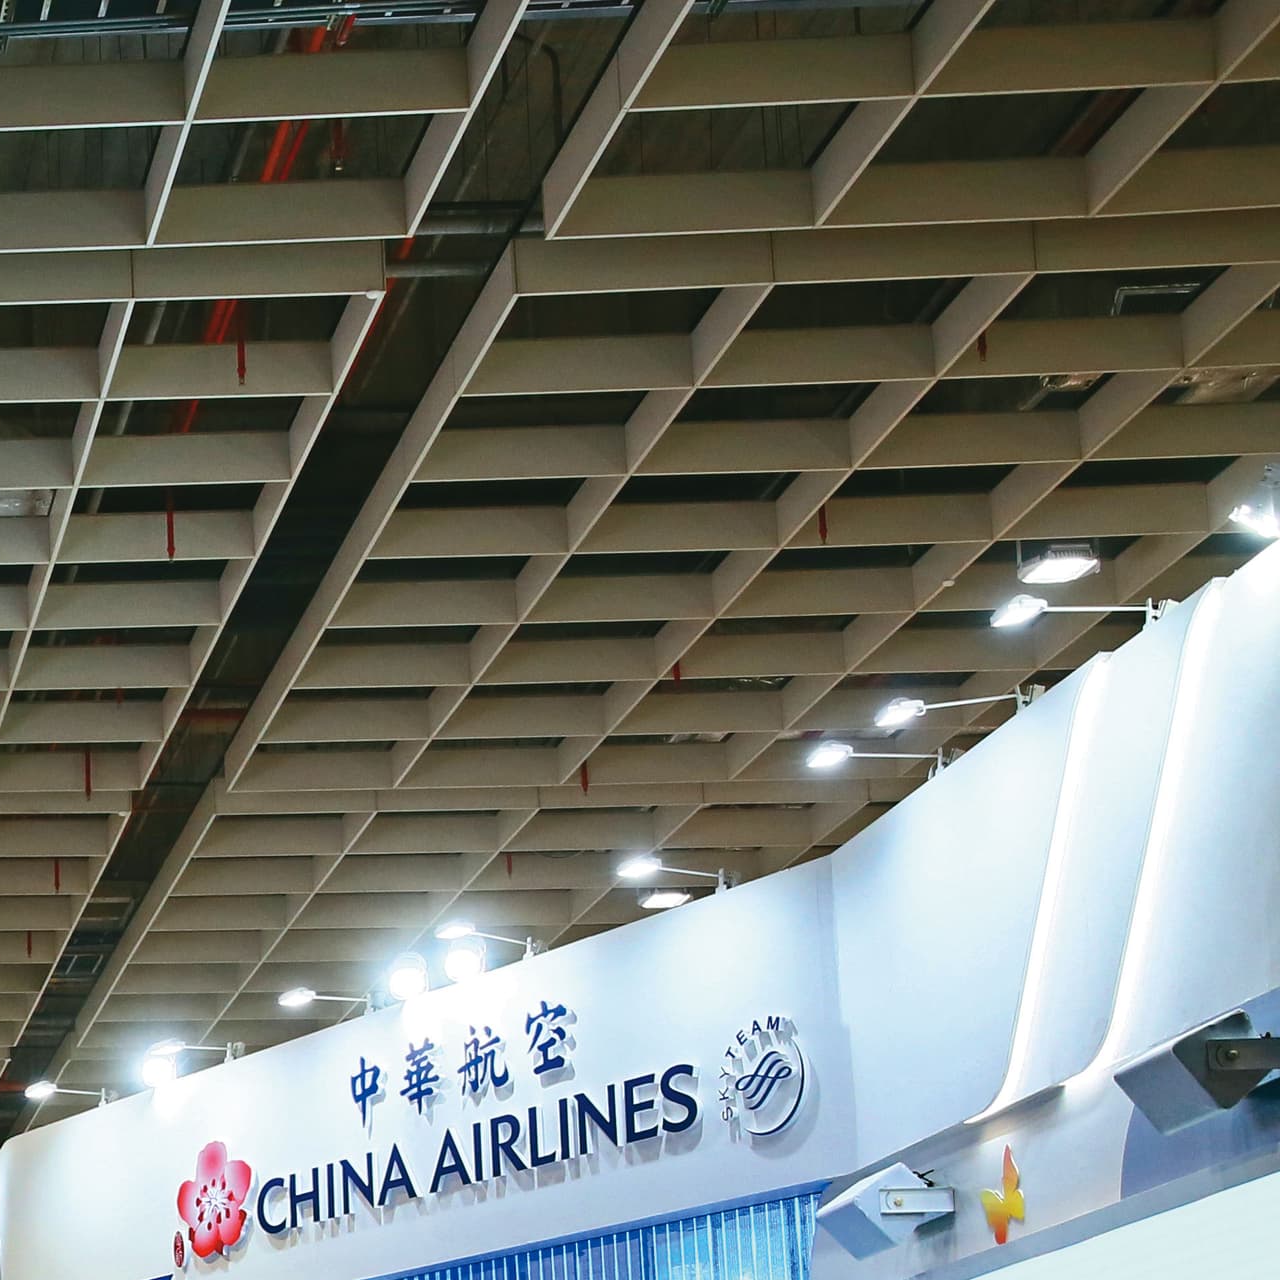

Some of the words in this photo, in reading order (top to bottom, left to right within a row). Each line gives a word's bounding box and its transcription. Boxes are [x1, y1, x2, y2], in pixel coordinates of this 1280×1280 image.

[349, 1001, 570, 1127] 中華航空
[719, 1015, 781, 1122] SKYTEAM
[256, 1142, 420, 1235] CHINA
[429, 1063, 699, 1193] AIRLINES
